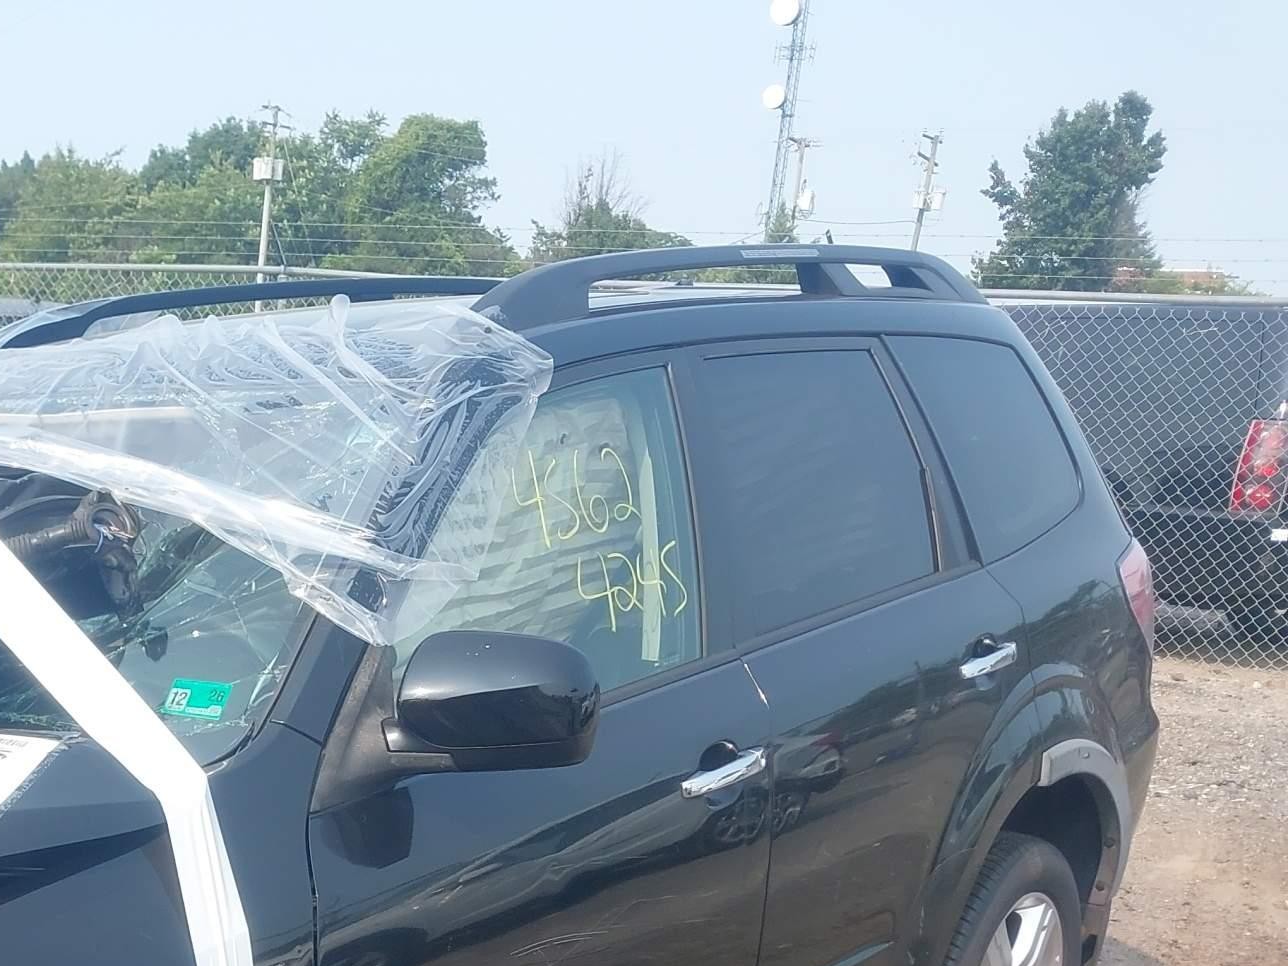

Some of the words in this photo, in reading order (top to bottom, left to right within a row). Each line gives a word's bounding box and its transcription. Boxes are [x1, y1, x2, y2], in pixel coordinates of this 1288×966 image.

[511, 446, 642, 549] 4562
[576, 540, 688, 633] 4245
[168, 690, 188, 706] 12
[208, 688, 226, 703] 26
